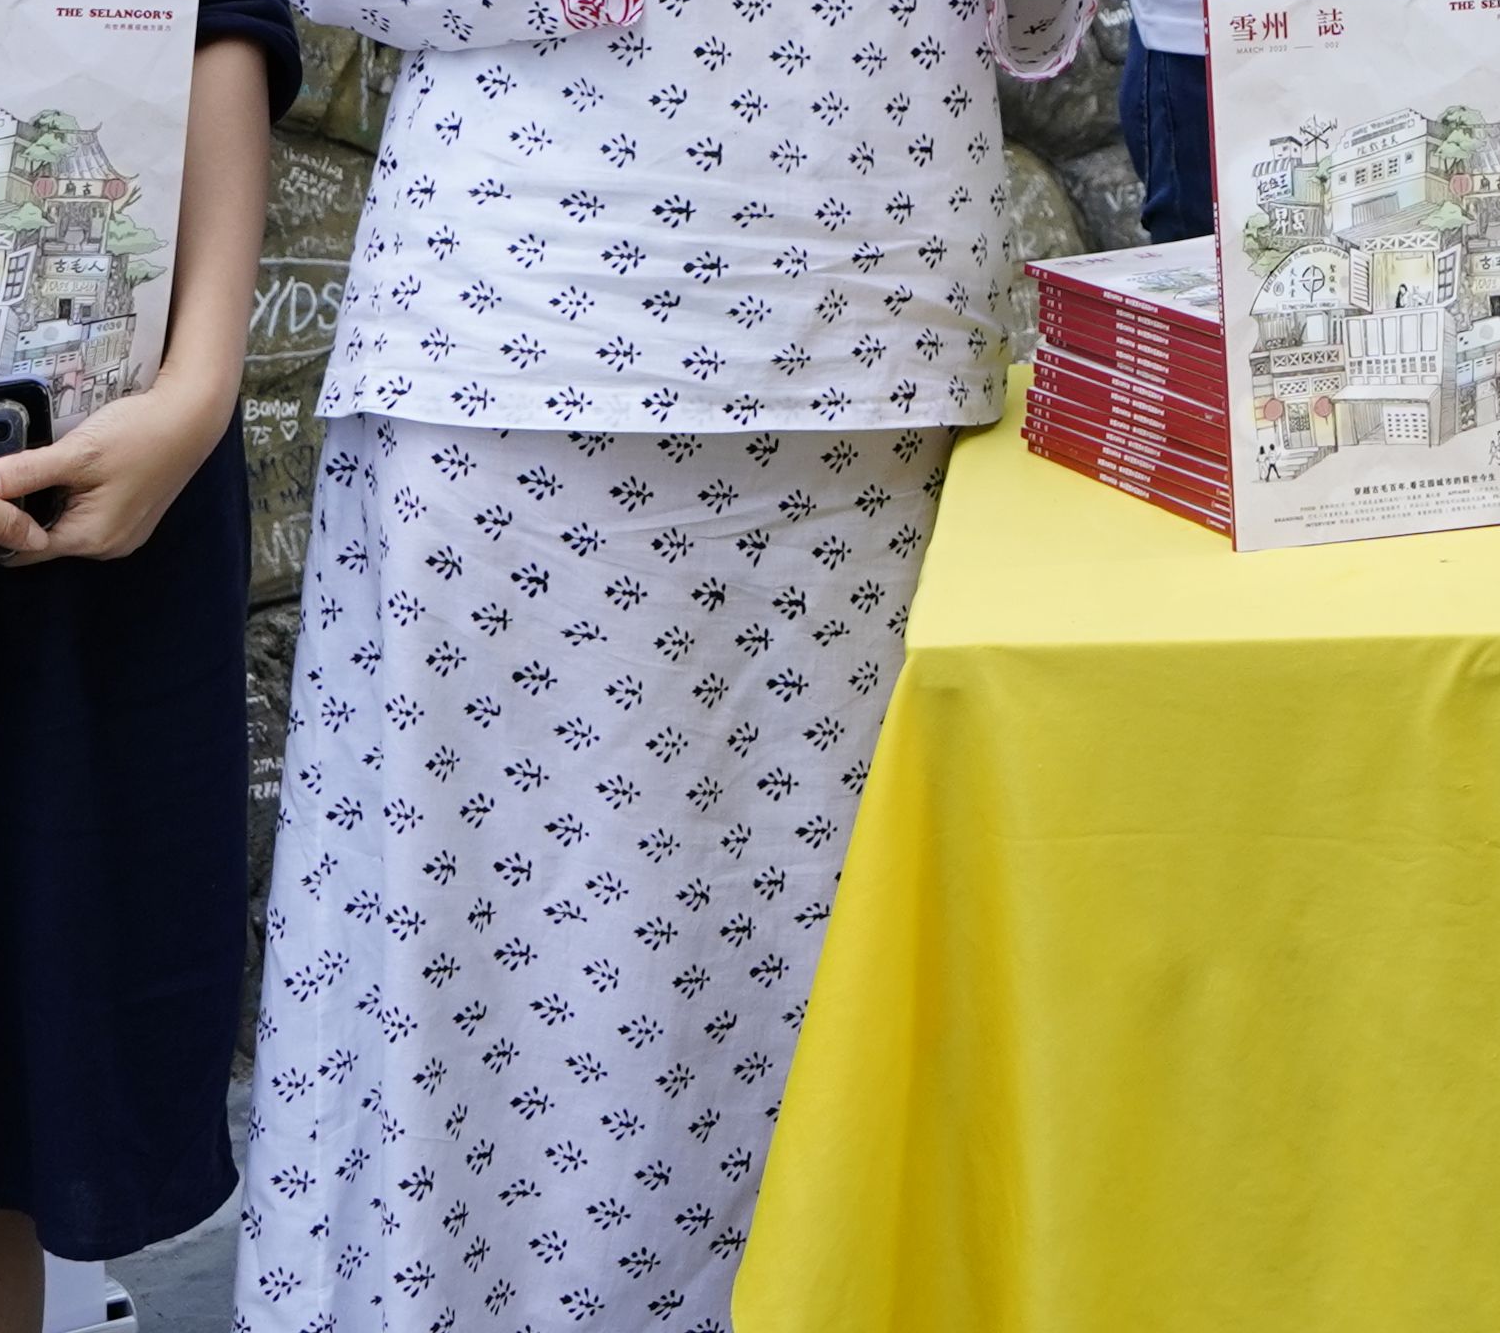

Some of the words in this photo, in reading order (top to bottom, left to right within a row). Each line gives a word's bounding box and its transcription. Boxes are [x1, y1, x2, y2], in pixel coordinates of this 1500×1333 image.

[1449, 1, 1475, 11] THE
[56, 8, 83, 18] THE
[89, 8, 174, 20] SELANGOR'S
